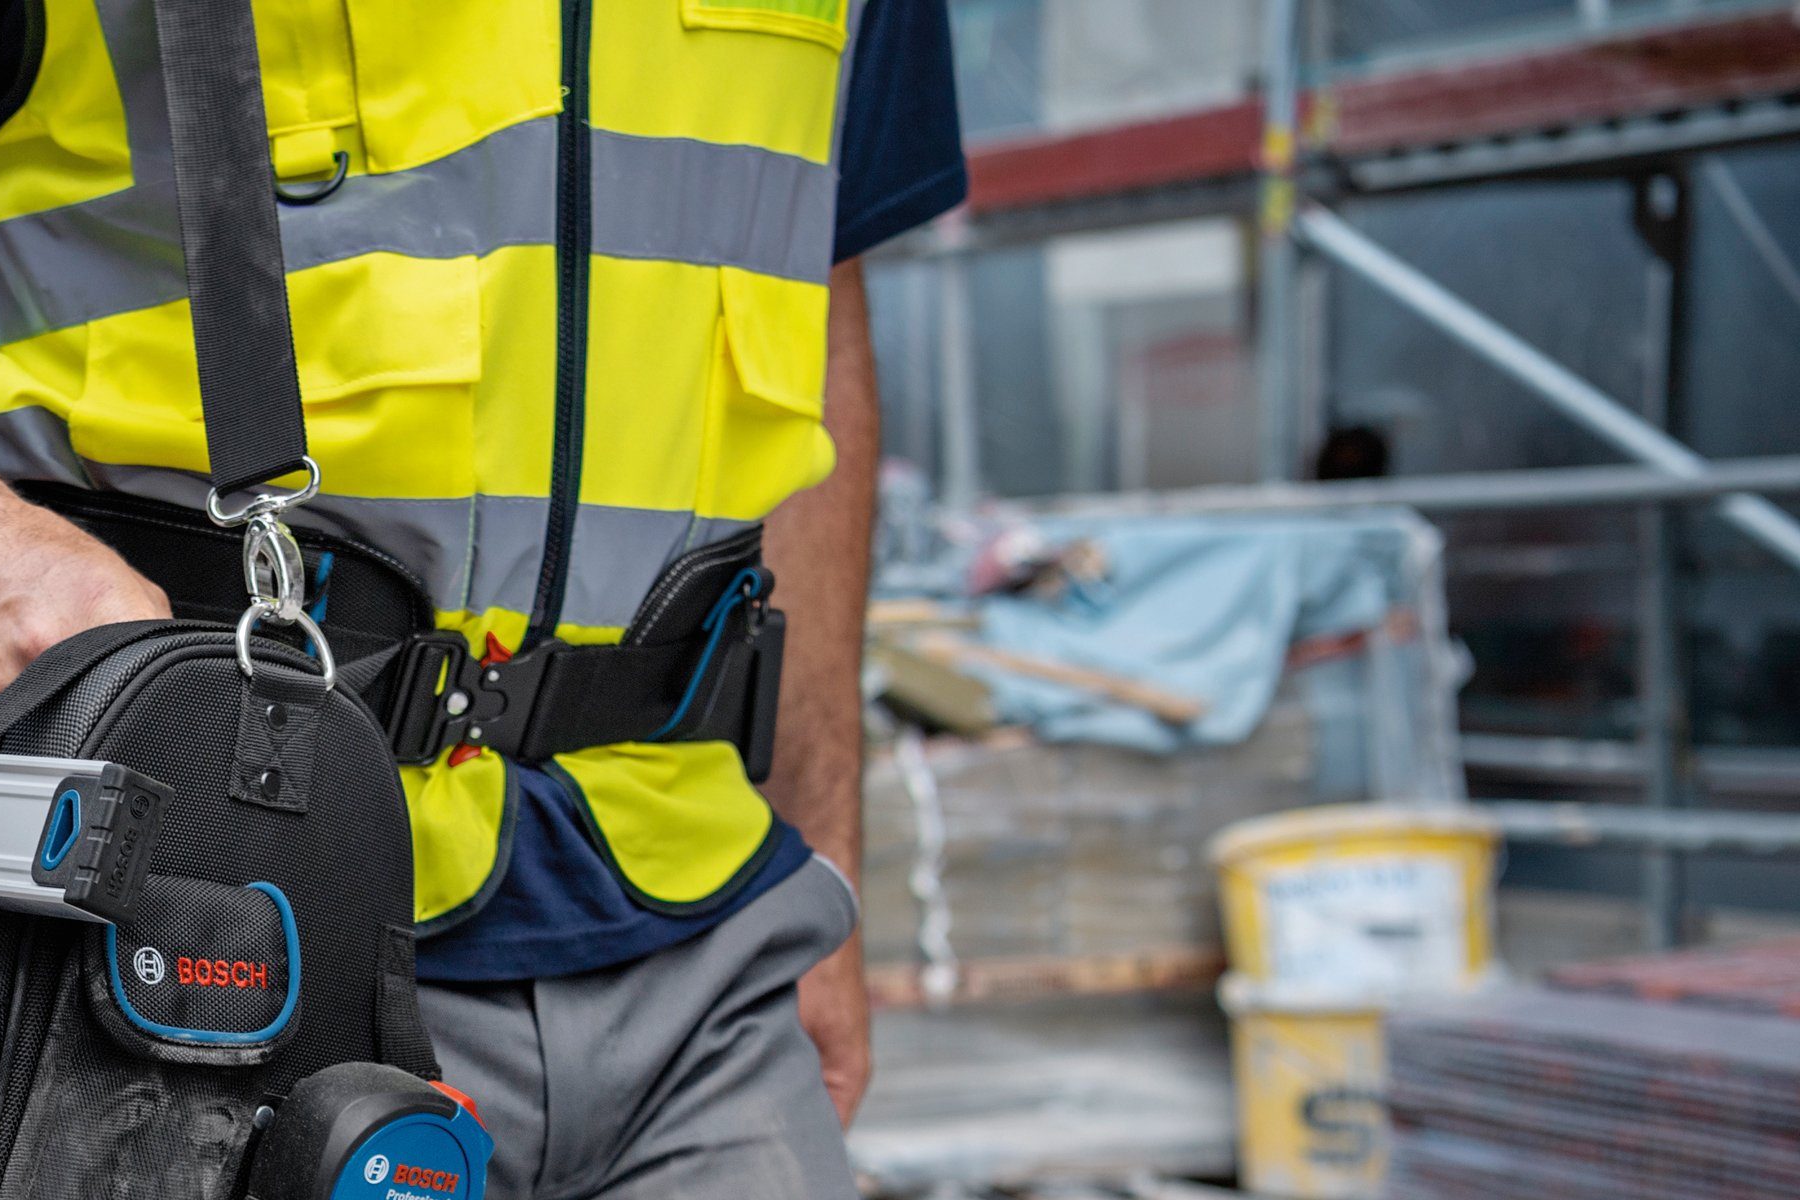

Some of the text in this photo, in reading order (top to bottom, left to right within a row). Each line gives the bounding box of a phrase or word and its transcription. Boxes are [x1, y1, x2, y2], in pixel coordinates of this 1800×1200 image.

[104, 826, 138, 899] BOSCH
[177, 956, 268, 990] BOSCH
[392, 1163, 460, 1194] BOSCH
